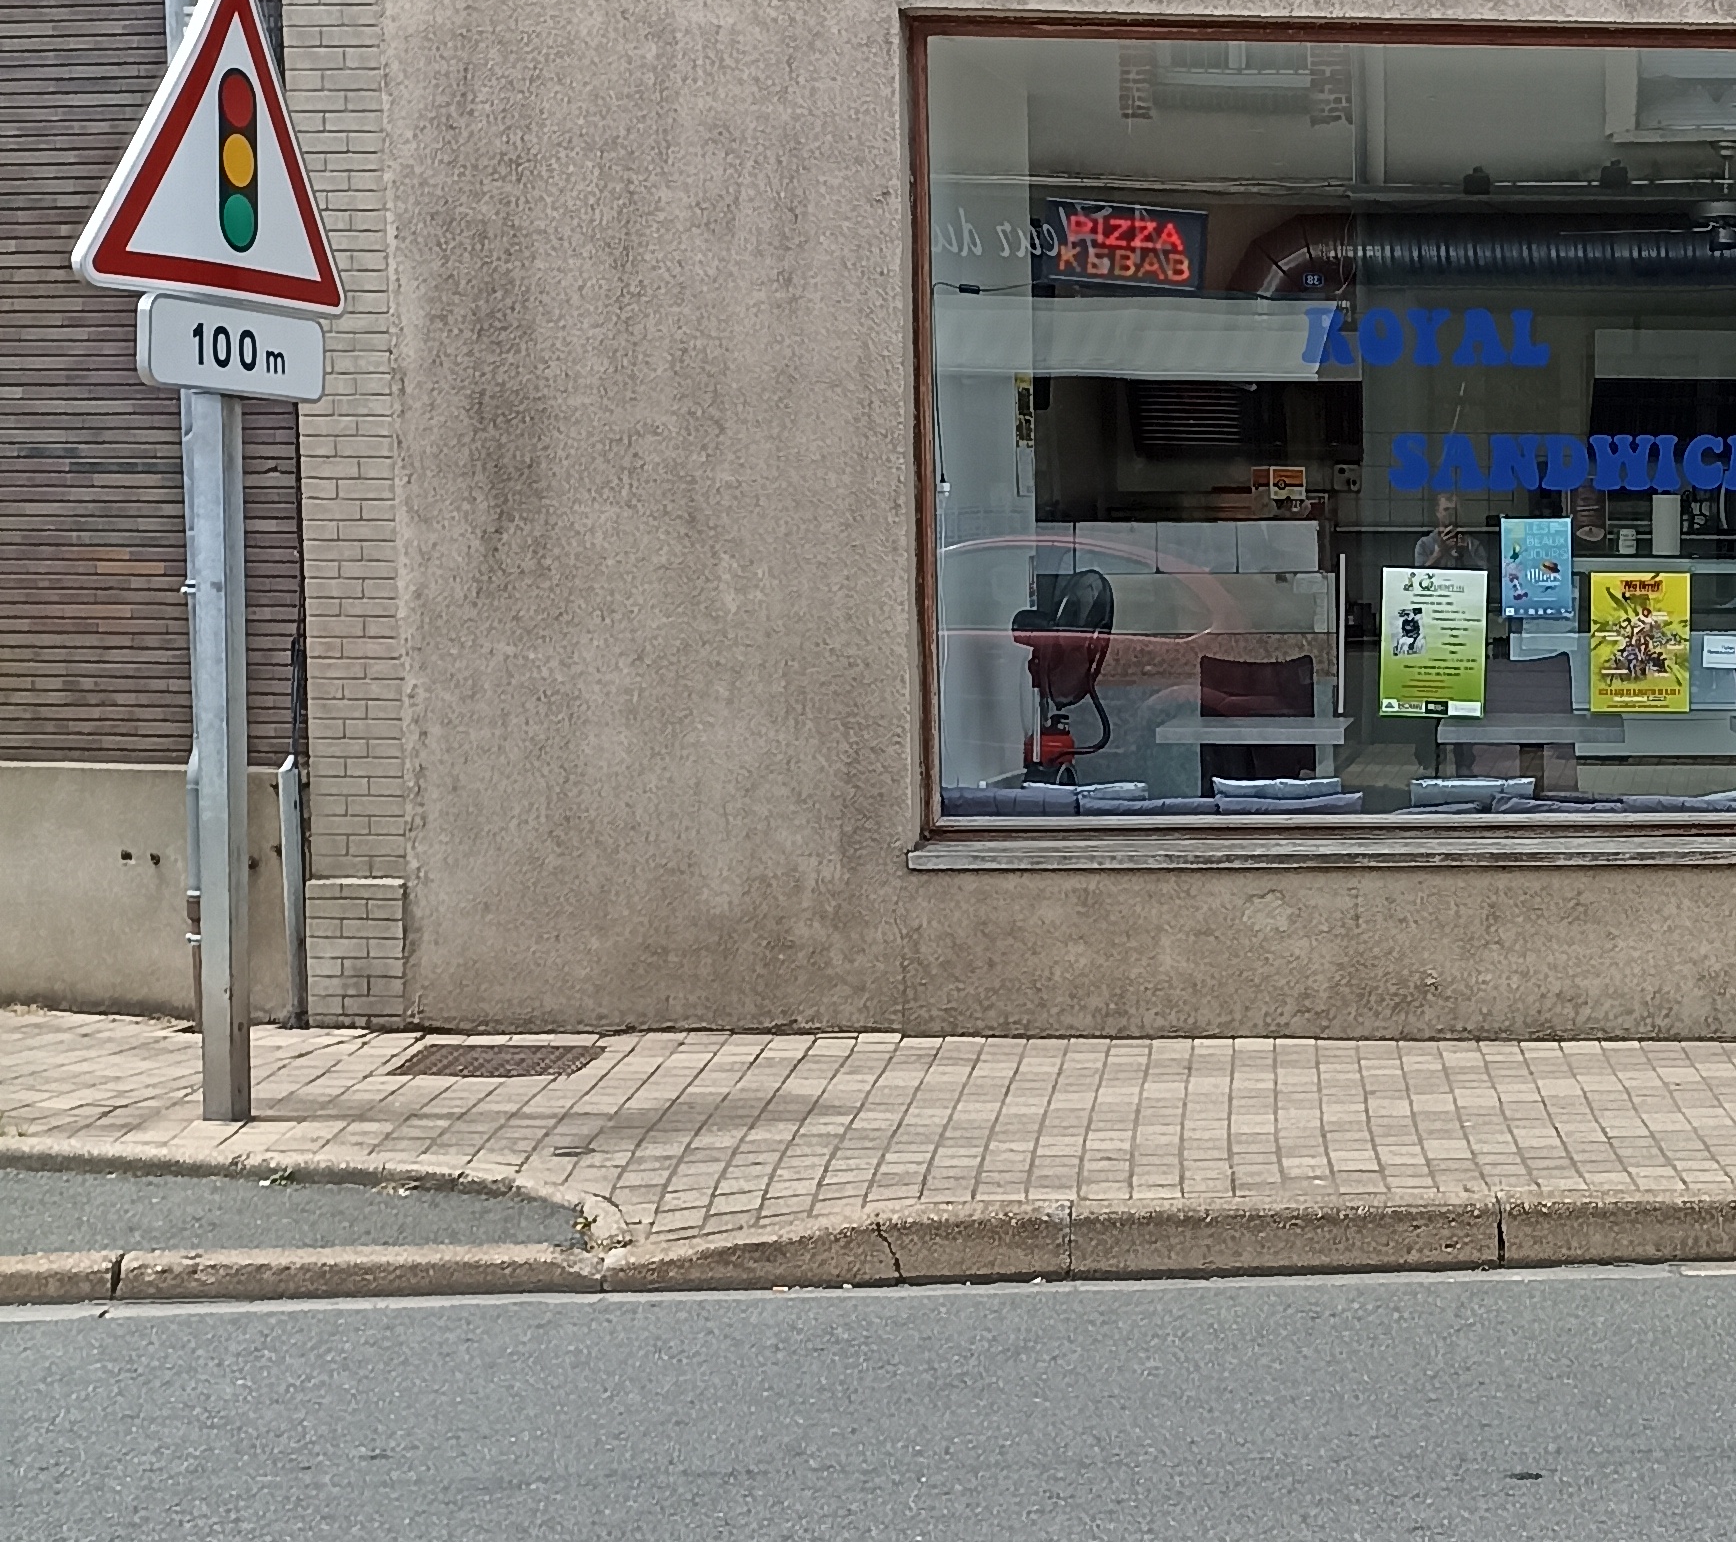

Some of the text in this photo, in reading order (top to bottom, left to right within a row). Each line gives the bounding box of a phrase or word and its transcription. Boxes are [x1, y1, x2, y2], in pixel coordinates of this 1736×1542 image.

[1068, 215, 1184, 251] PIZZA
[1058, 244, 1191, 281] KEBAB
[1301, 307, 1551, 367] ROYAL
[1526, 522, 1549, 534] LES
[1526, 535, 1566, 547] BEAUX
[1526, 548, 1569, 560] JOURS
